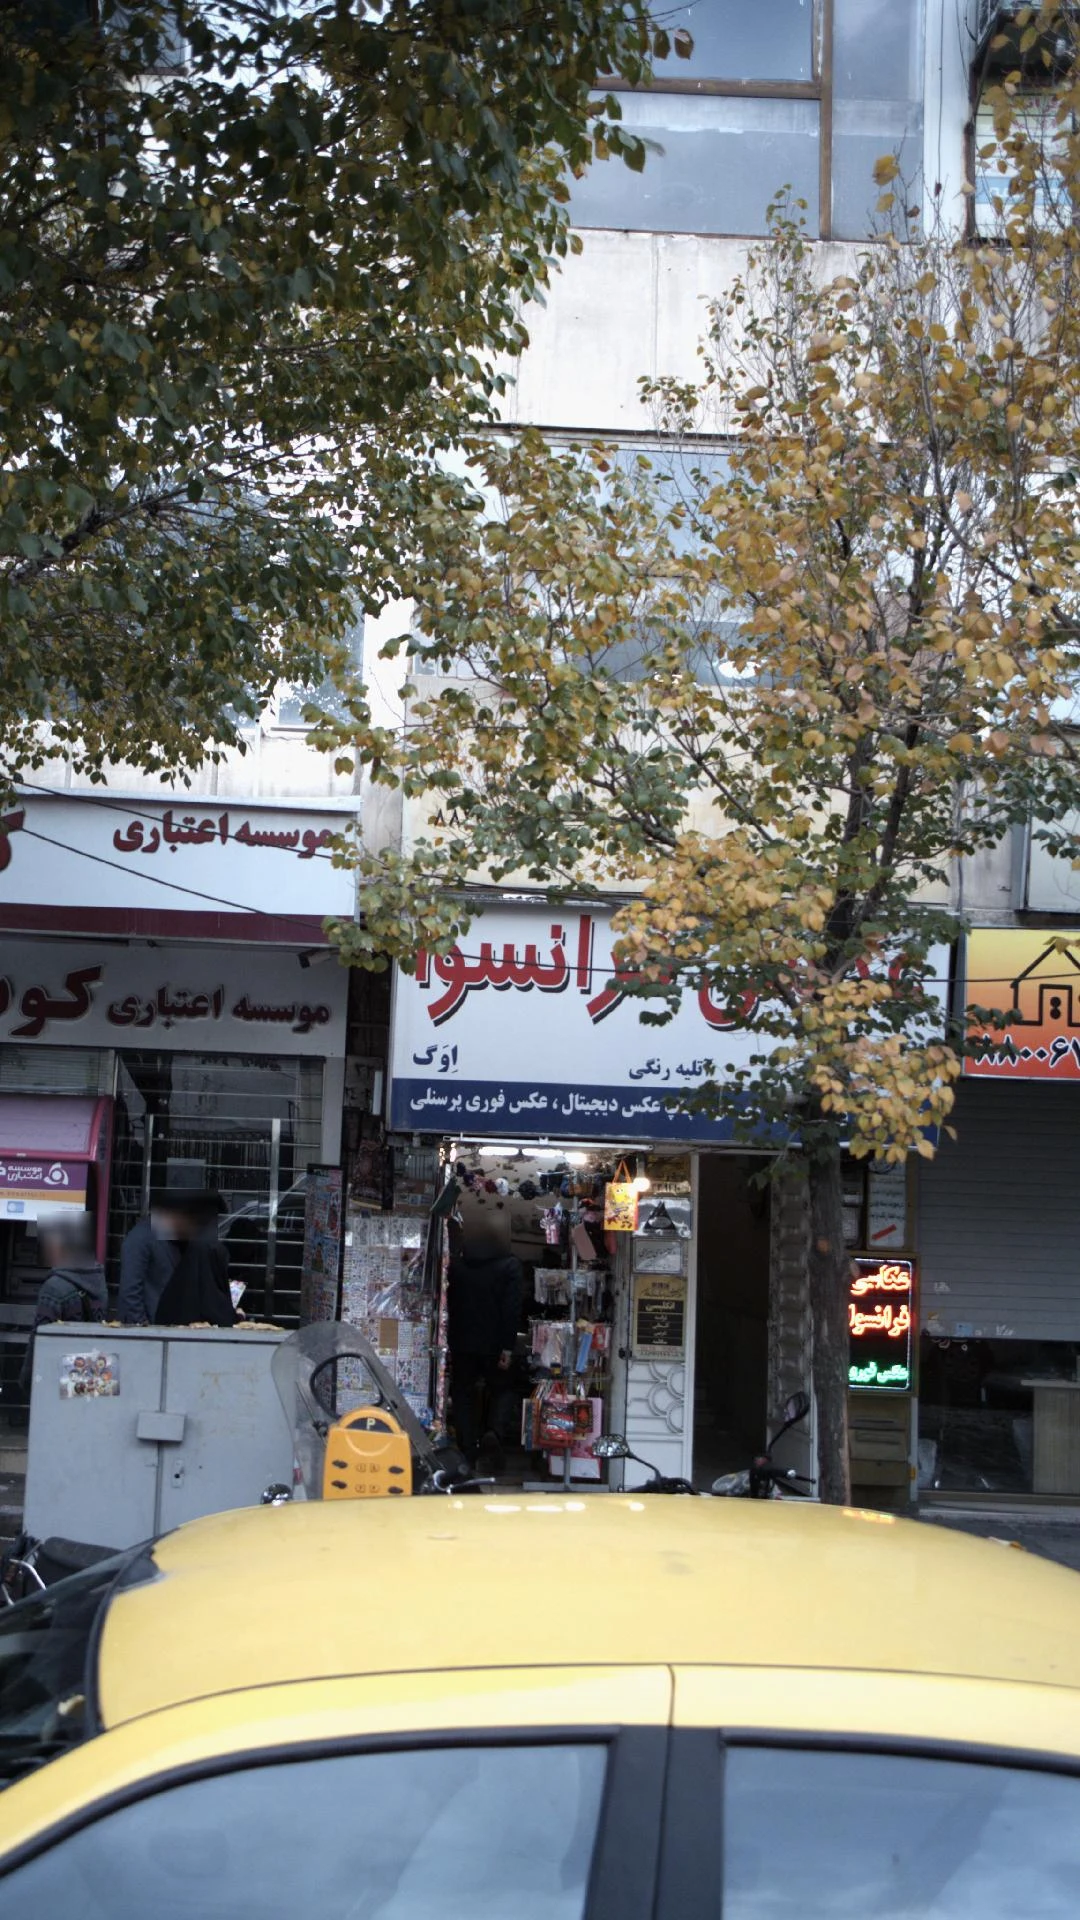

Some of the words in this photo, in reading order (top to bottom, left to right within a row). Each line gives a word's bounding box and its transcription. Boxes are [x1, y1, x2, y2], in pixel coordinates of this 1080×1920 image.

[113, 810, 229, 853] اعتباری
[235, 821, 333, 858] موسسه
[414, 914, 676, 1027] رانسوا
[0, 964, 102, 1037] کو
[107, 984, 225, 1029] اعتباری
[233, 996, 331, 1034] موسسه
[629, 1058, 671, 1080] رنگی
[410, 1087, 462, 1112] پرسنلی
[465, 1088, 505, 1112] فوری
[508, 1091, 548, 1113] عکس
[621, 1096, 661, 1118] عکس
[366, 1417, 376, 1430] P
